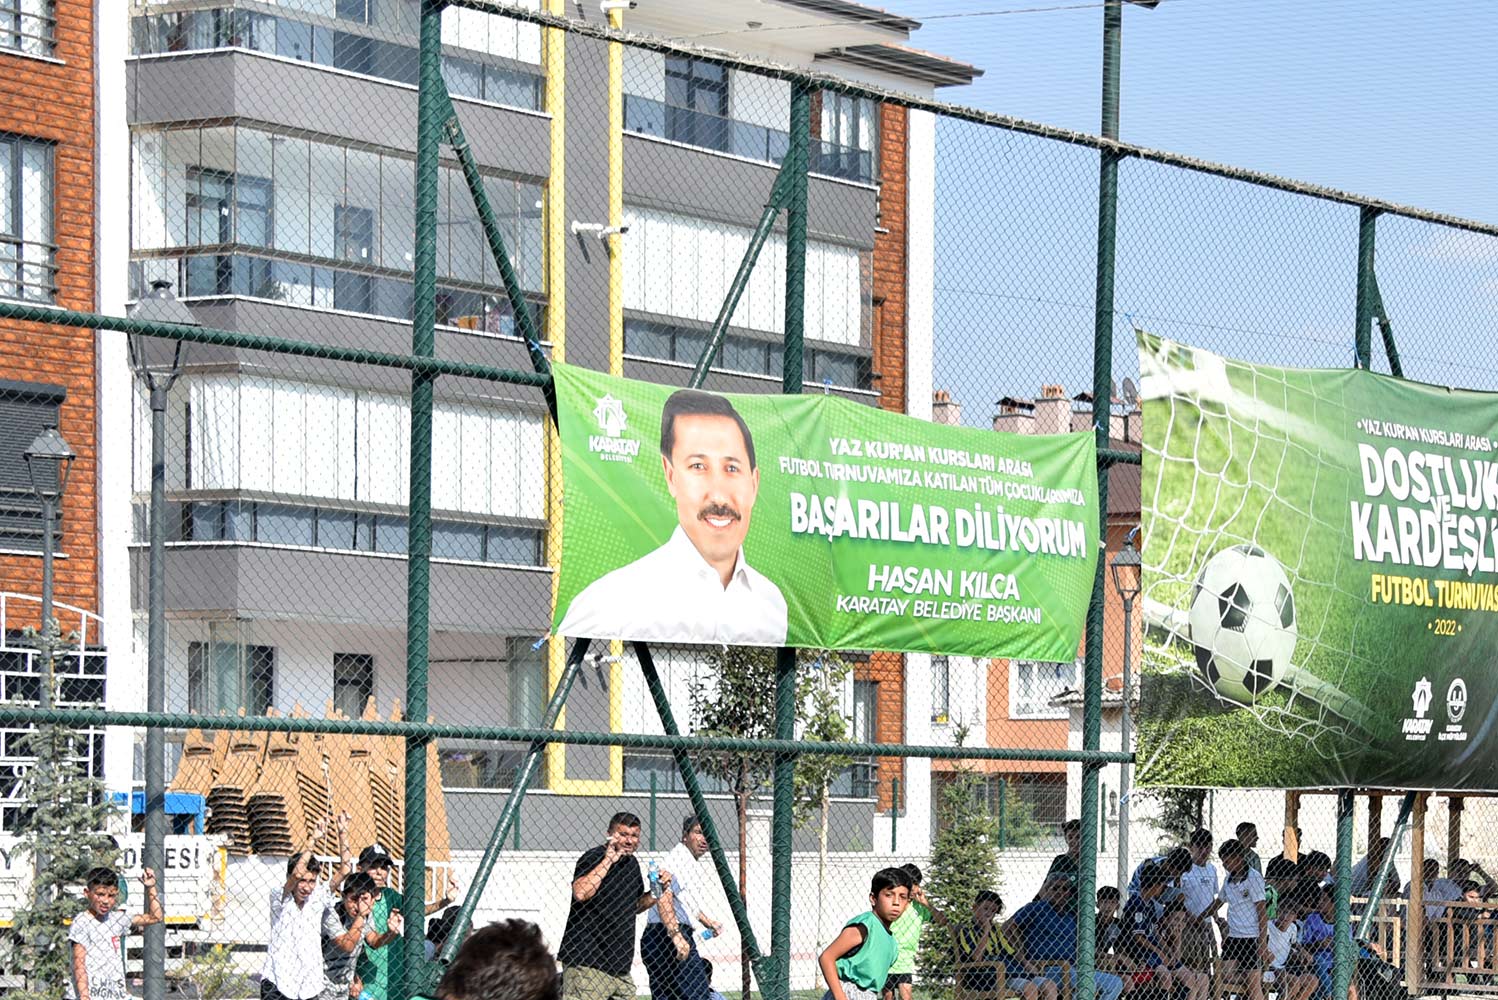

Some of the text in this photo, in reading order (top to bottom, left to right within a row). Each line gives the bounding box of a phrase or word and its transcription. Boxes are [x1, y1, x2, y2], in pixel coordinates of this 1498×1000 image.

[589, 435, 641, 456] KARATAY
[1361, 418, 1492, 452] YAZ KUR'AN KURSLARI ARASI
[829, 437, 1034, 478] YAZ KUR'AN KURSLARI ARASI
[778, 456, 823, 478] FUTBOL
[823, 461, 923, 488] TURNUVAMIZA
[924, 470, 978, 494] KATILAN
[978, 476, 1004, 497] TÜM
[790, 491, 1087, 558] BAŞARILAR DİLİYORUM
[1429, 494, 1451, 523] VE
[867, 564, 1021, 601] HASAN KILCA
[1371, 574, 1433, 607] FUTBOL
[836, 595, 1041, 625] KARATAY BELEDİYE BAŞKANI
[1434, 619, 1456, 636] 2022
